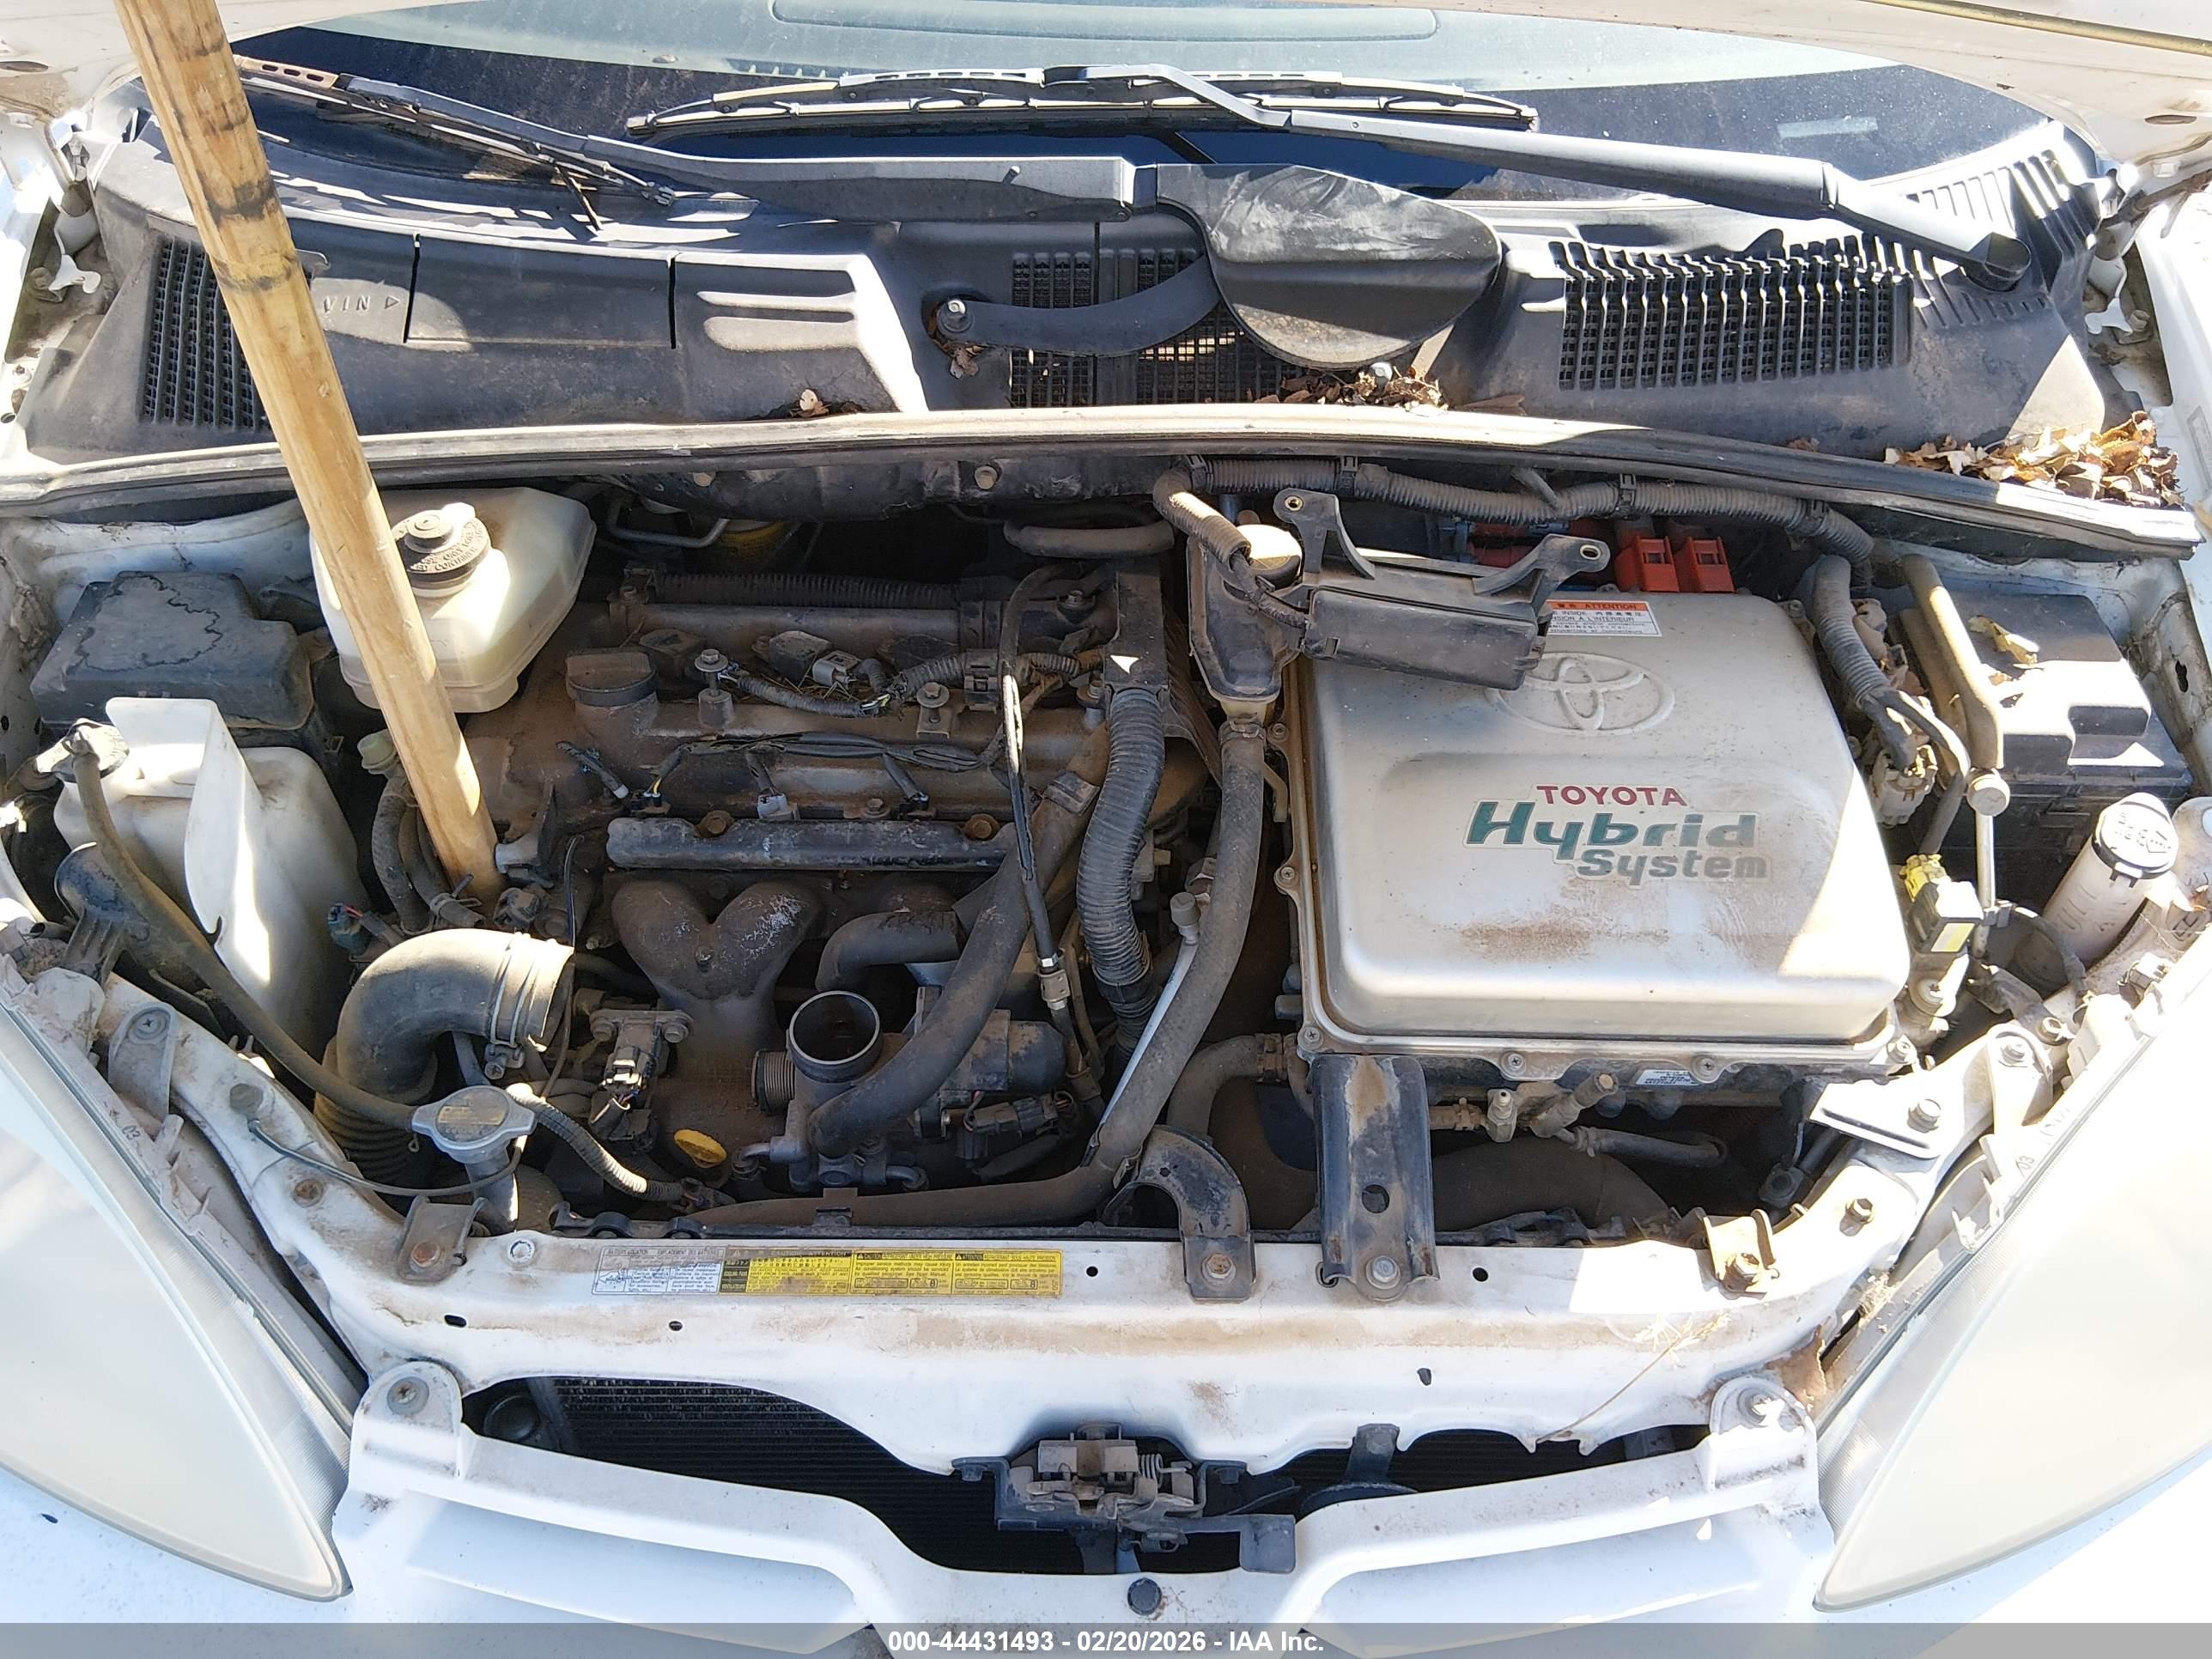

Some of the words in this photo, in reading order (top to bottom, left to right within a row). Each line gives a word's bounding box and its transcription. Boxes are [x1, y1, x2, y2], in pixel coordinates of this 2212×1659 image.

[324, 295, 370, 313] VIN
[1536, 786, 1687, 806] TOYOTA
[1467, 801, 1756, 860] Hybrid
[1577, 848, 1767, 886] System
